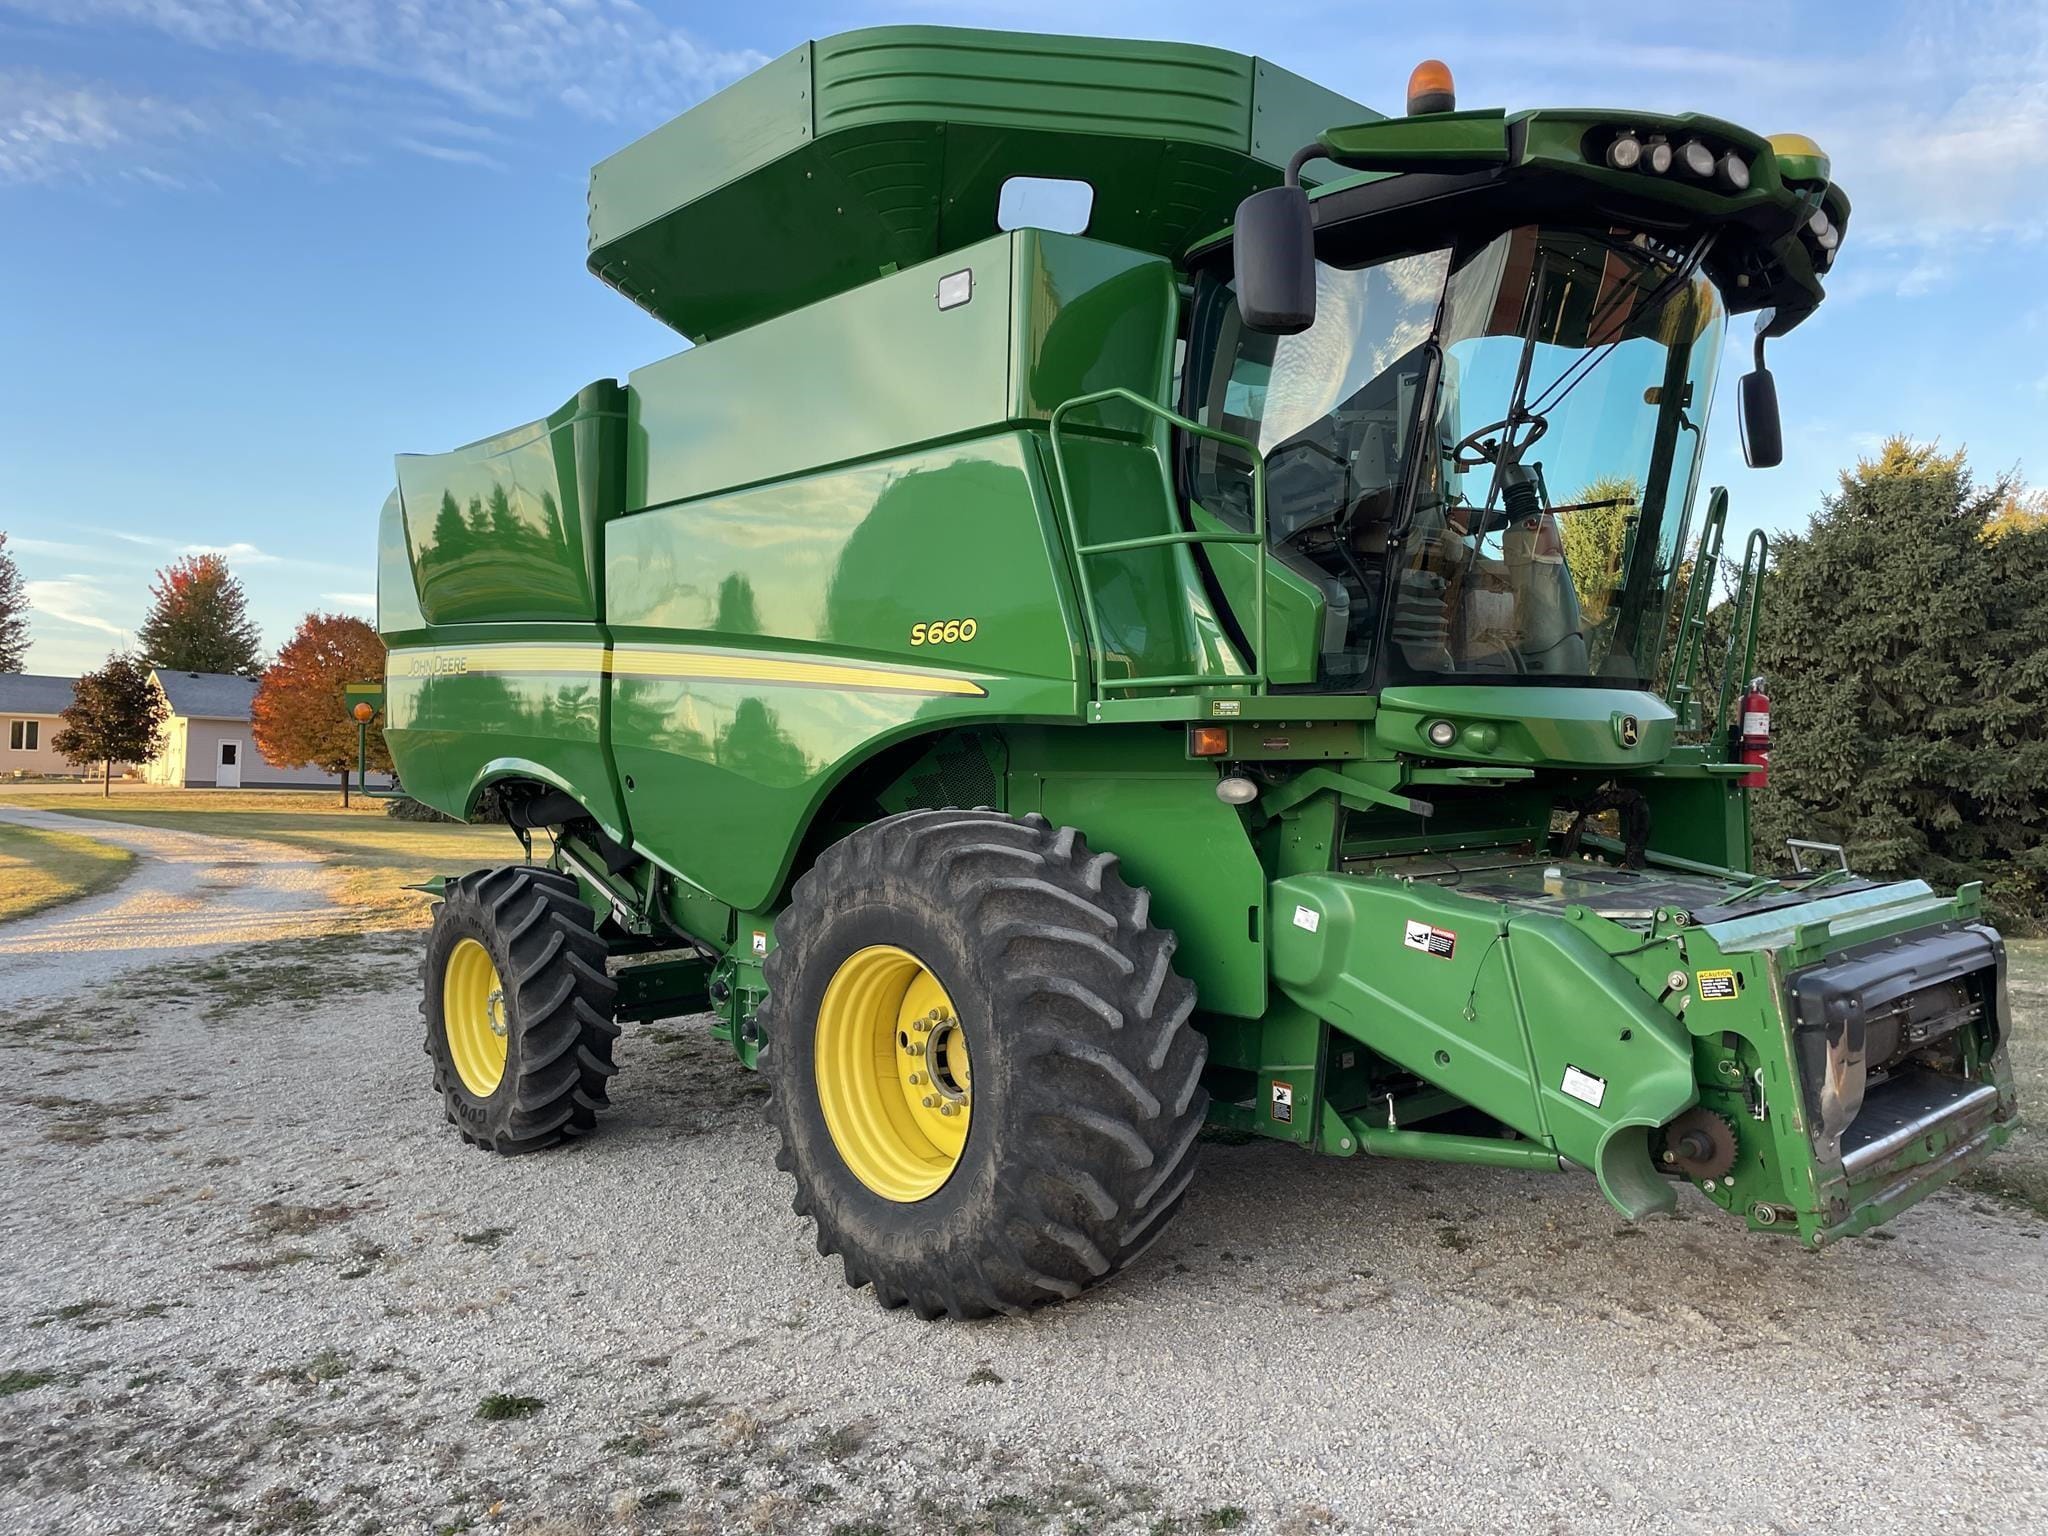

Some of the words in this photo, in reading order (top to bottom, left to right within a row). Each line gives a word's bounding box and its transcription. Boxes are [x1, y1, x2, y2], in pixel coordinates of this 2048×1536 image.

[910, 617, 978, 646] S660
[408, 657, 433, 676] JOHN
[434, 655, 467, 674] DEERE
